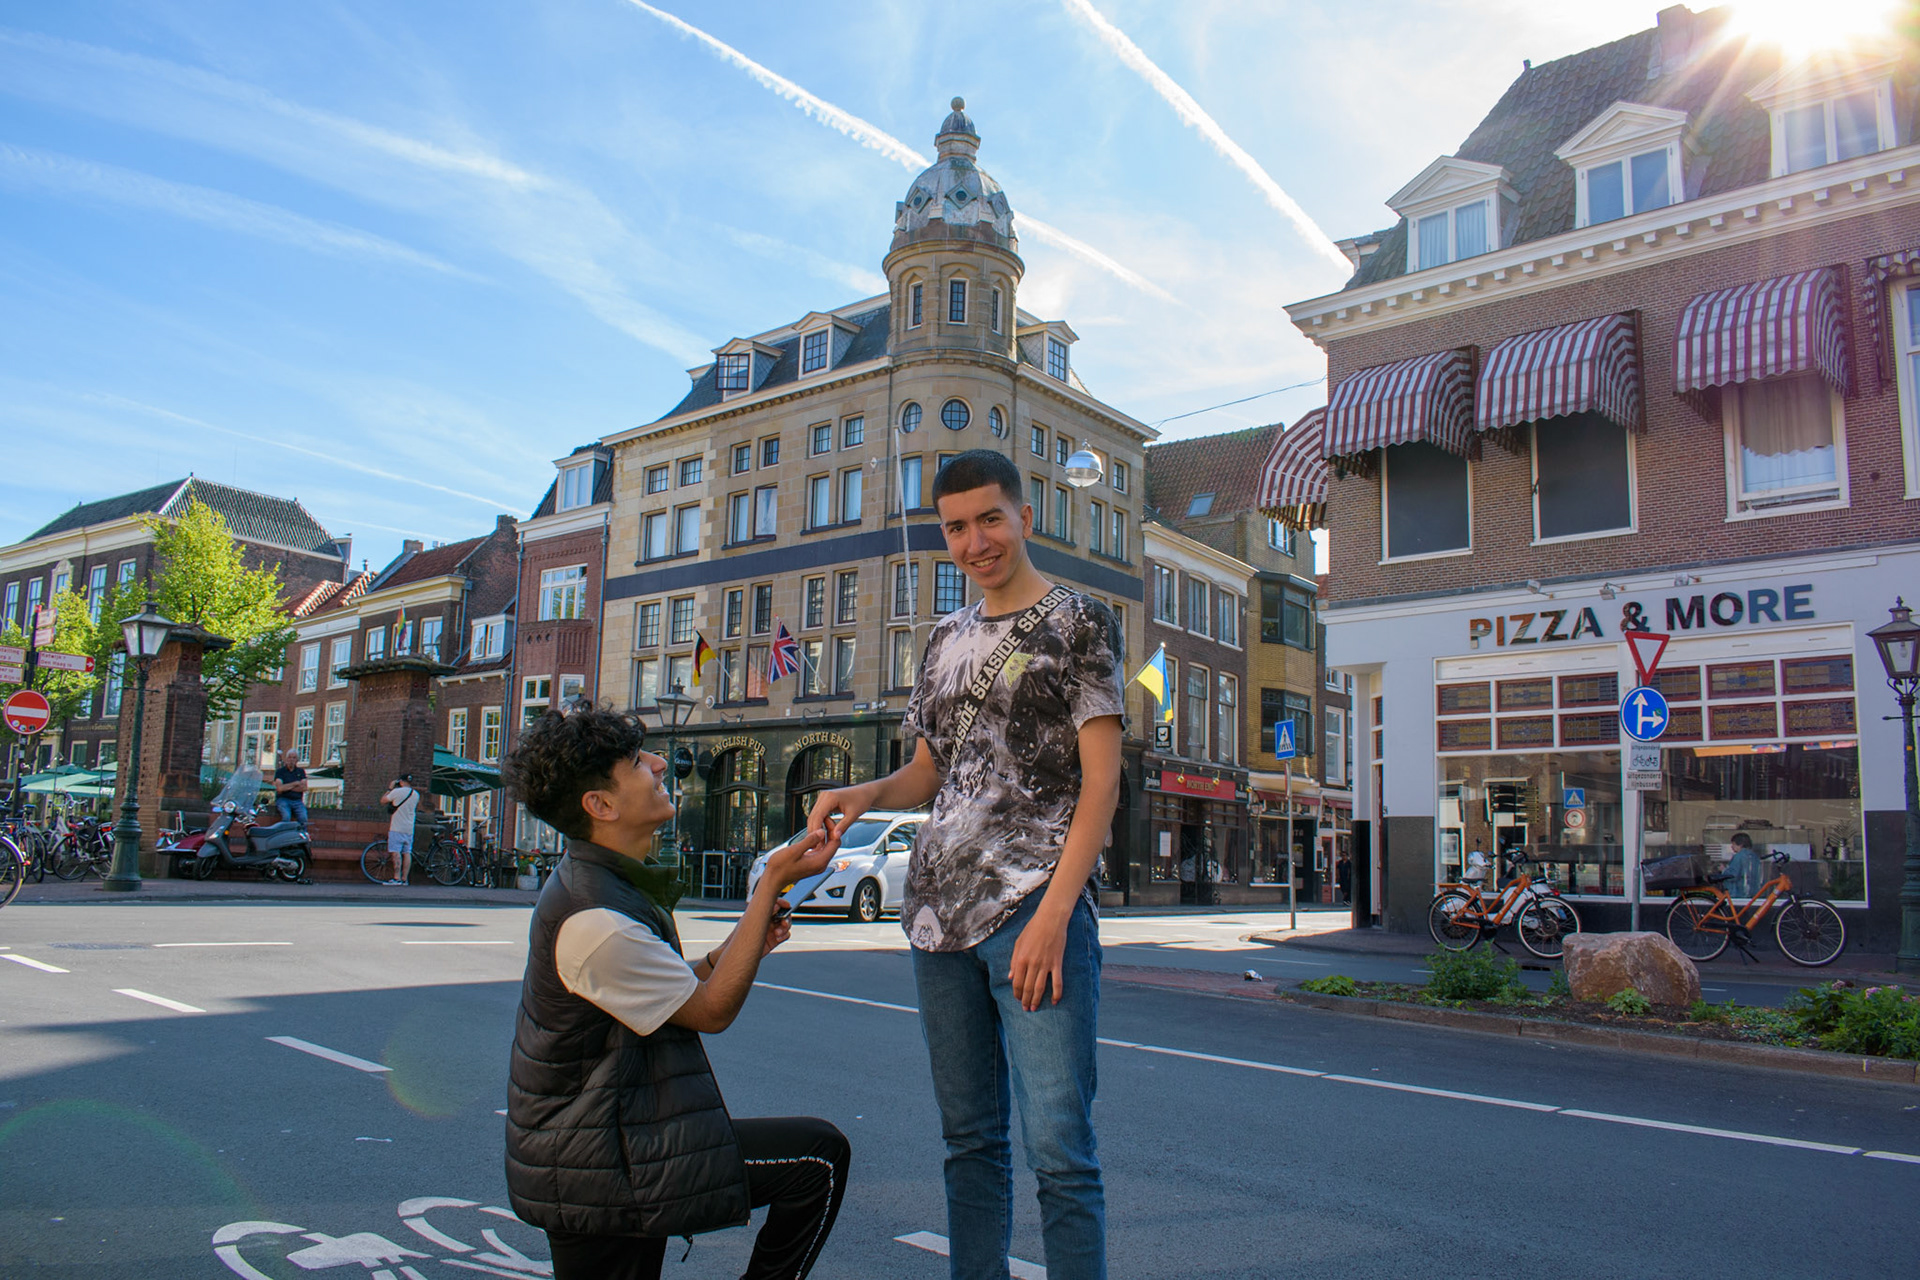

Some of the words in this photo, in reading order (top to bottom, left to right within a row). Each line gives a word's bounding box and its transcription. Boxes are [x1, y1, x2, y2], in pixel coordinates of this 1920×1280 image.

[1018, 588, 1070, 634] SEASID
[1470, 607, 1604, 649] PIZZA
[1620, 602, 1650, 632] &
[1666, 583, 1815, 630] MORE
[971, 632, 1021, 701] SEASIDE
[710, 735, 748, 757] ENGLISH
[748, 736, 768, 756] PUB
[794, 732, 830, 751] NORTH
[830, 732, 852, 751] END
[1627, 773, 1661, 781] uitgezonderd
